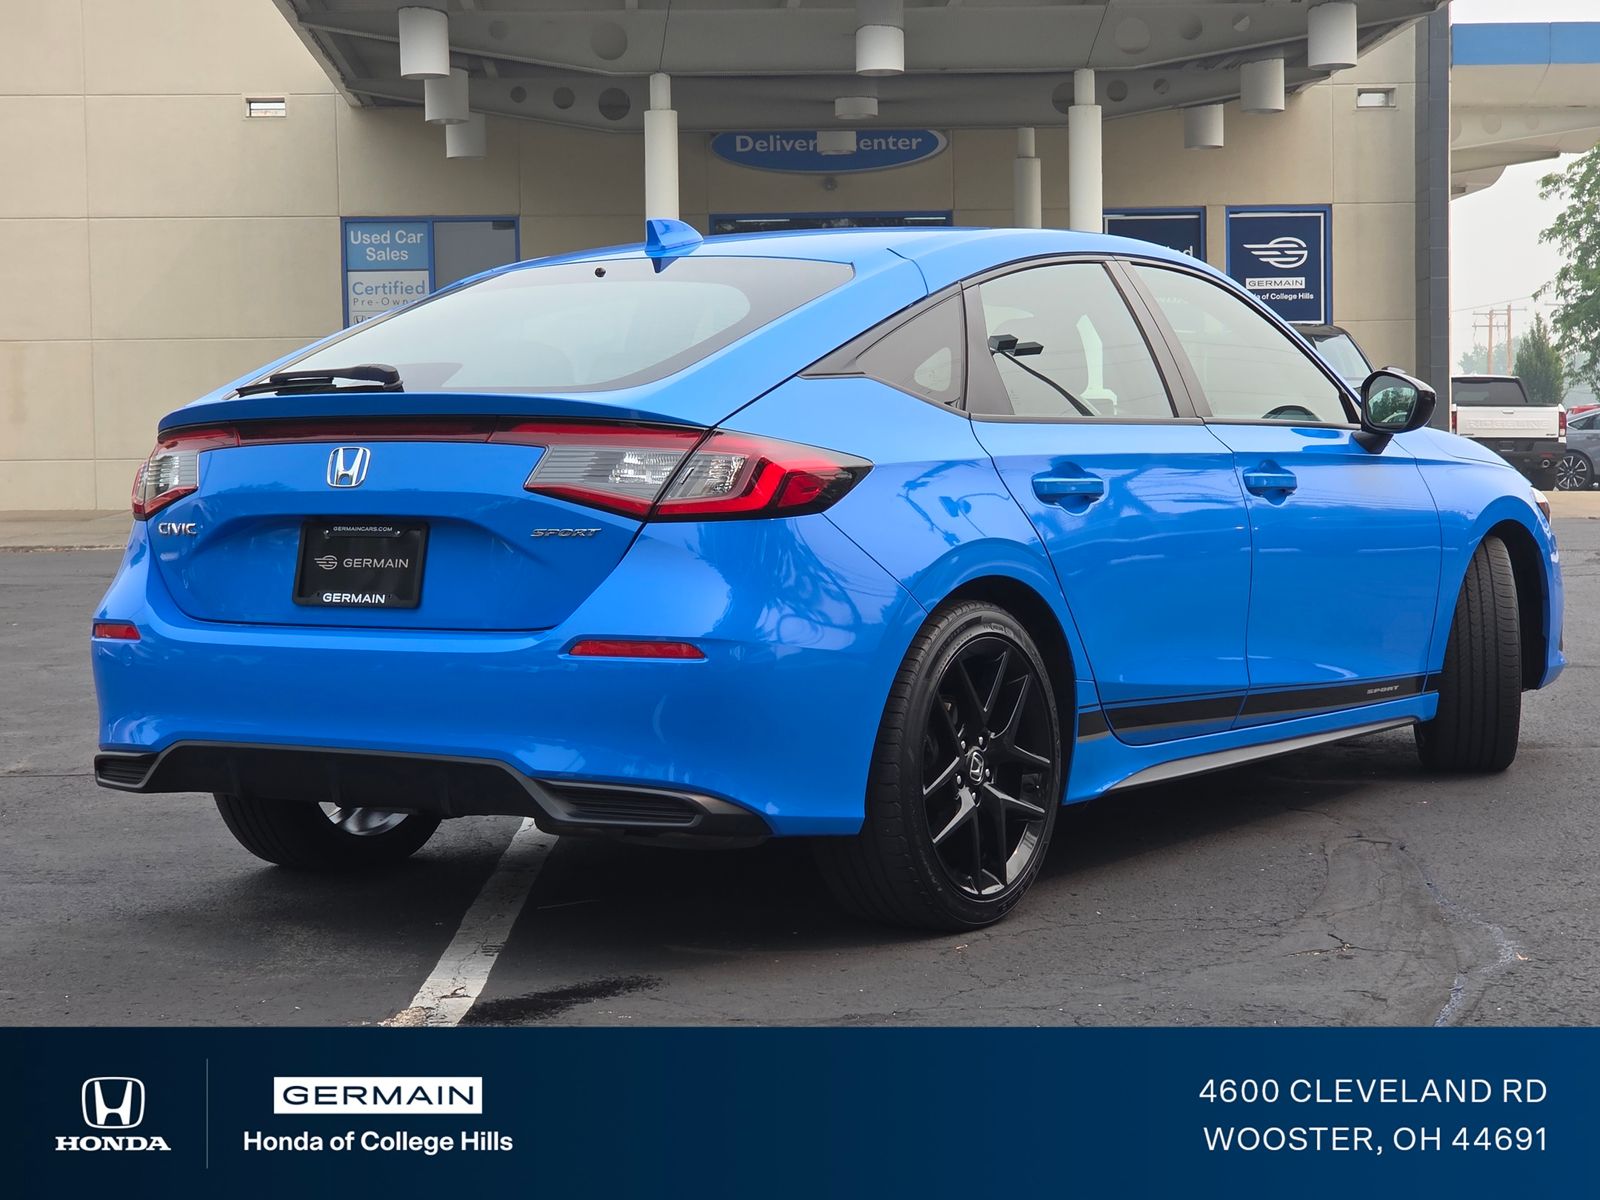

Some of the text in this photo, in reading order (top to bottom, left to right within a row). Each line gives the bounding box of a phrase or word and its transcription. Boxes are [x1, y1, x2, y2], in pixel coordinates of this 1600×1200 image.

[735, 135, 922, 152] Deliver enter
[350, 230, 423, 244] Used Car
[366, 247, 409, 261] Sales
[352, 280, 425, 296] Certified
[353, 296, 411, 306] Pre-Own
[1270, 293, 1298, 301] College
[1298, 292, 1314, 300] Hills
[158, 522, 197, 535] CIVIC
[530, 528, 602, 537] SPORT
[342, 558, 409, 569] GERMAIN
[322, 592, 386, 604] GERMAIN
[1366, 685, 1399, 695] SPORT
